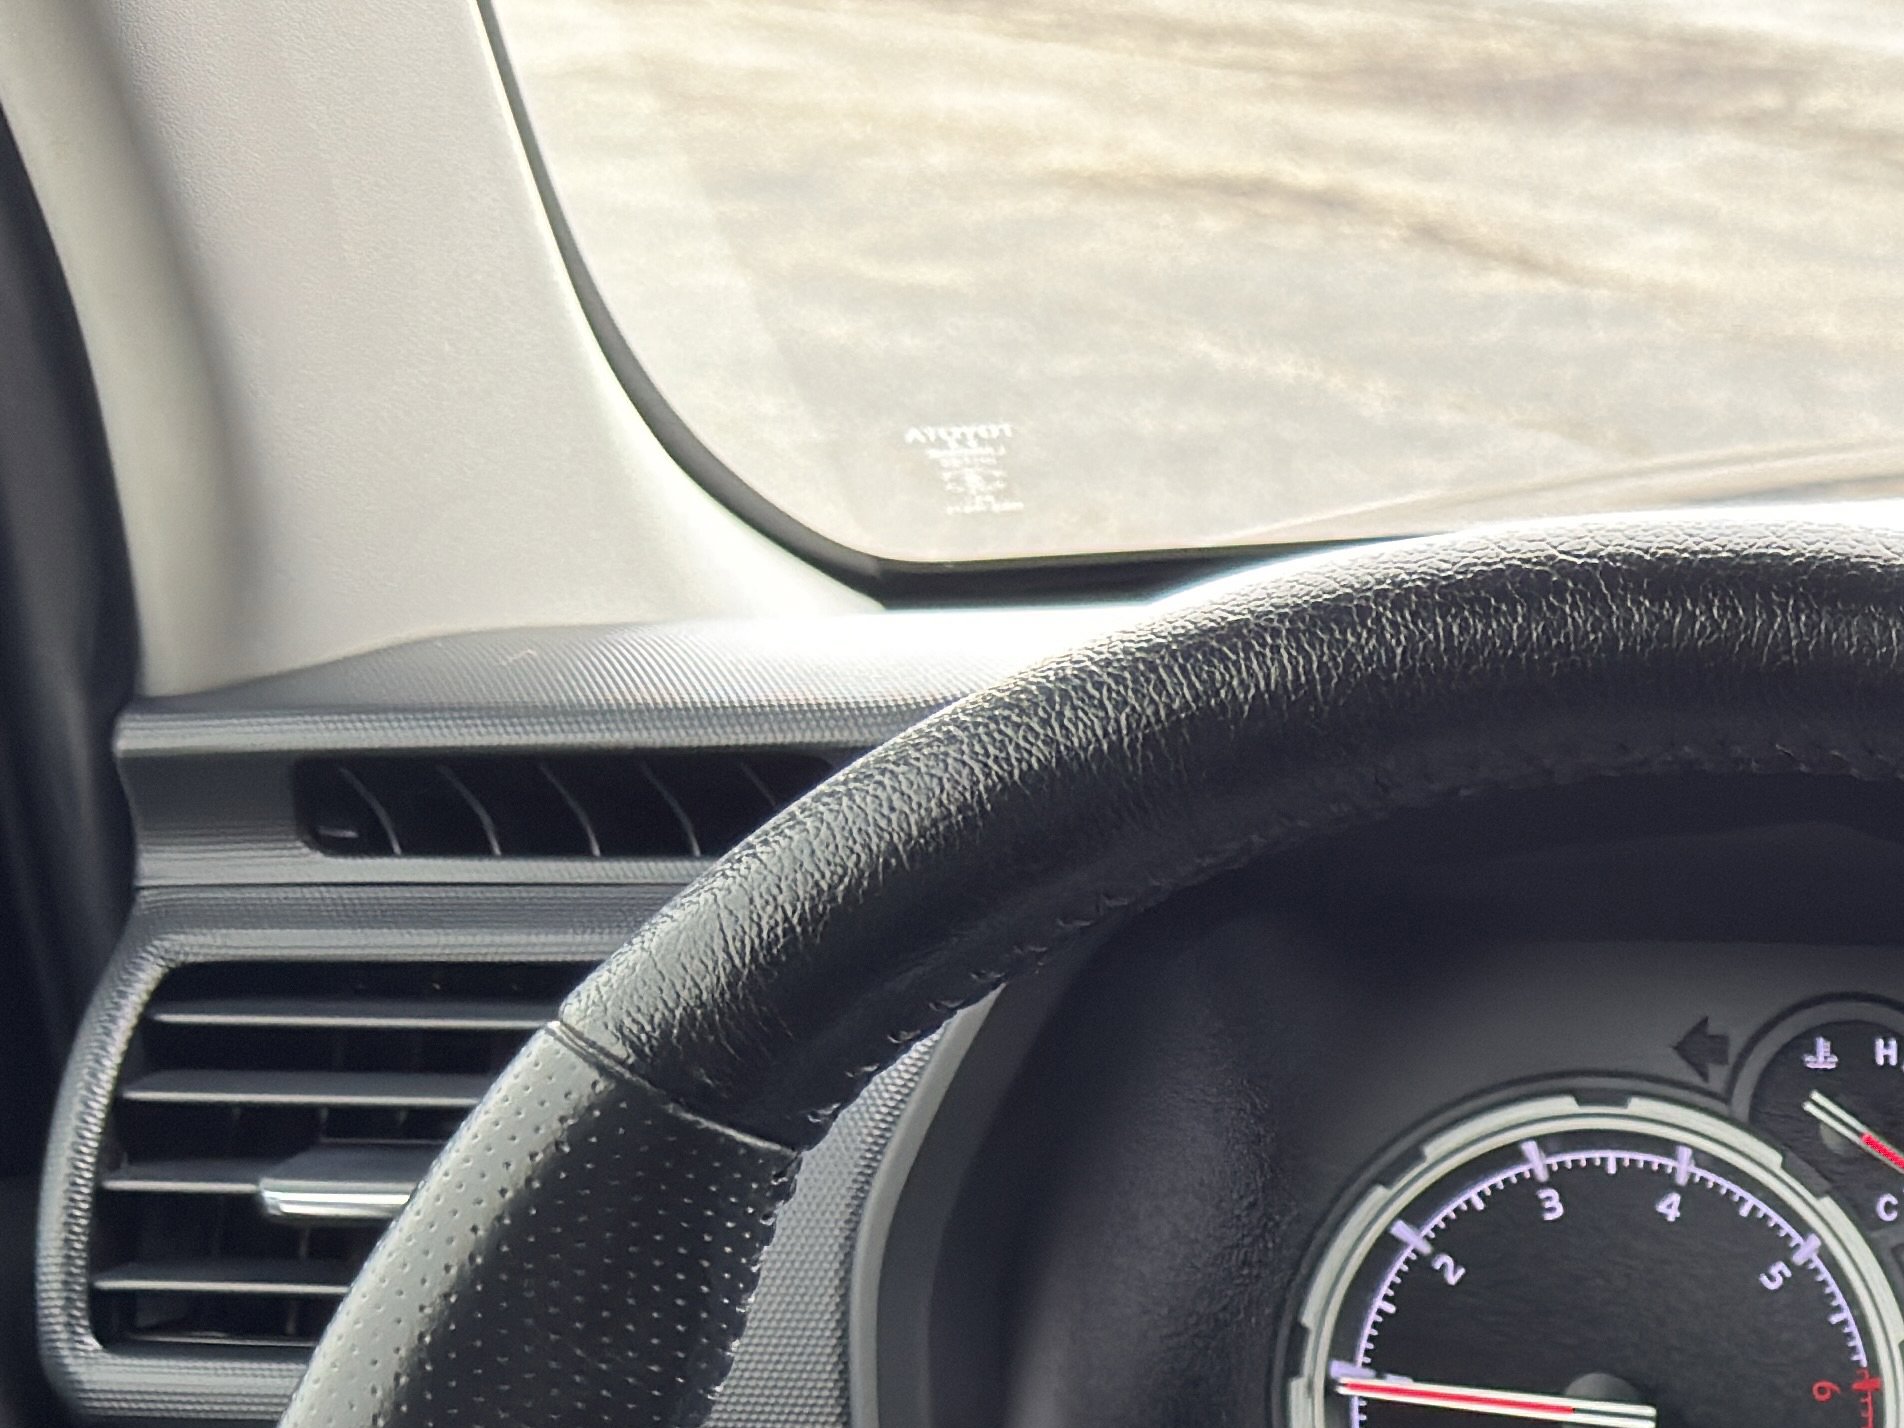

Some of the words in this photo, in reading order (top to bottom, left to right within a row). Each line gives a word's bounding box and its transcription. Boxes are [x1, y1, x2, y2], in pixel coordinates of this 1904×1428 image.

[1874, 1037, 1897, 1067] H
[1541, 1191, 1565, 1221] 3
[1655, 1191, 1682, 1222] 4
[1876, 1195, 1899, 1222] C
[1432, 1253, 1467, 1287] 2
[1759, 1261, 1793, 1292] 5
[1811, 1379, 1842, 1403] 6
